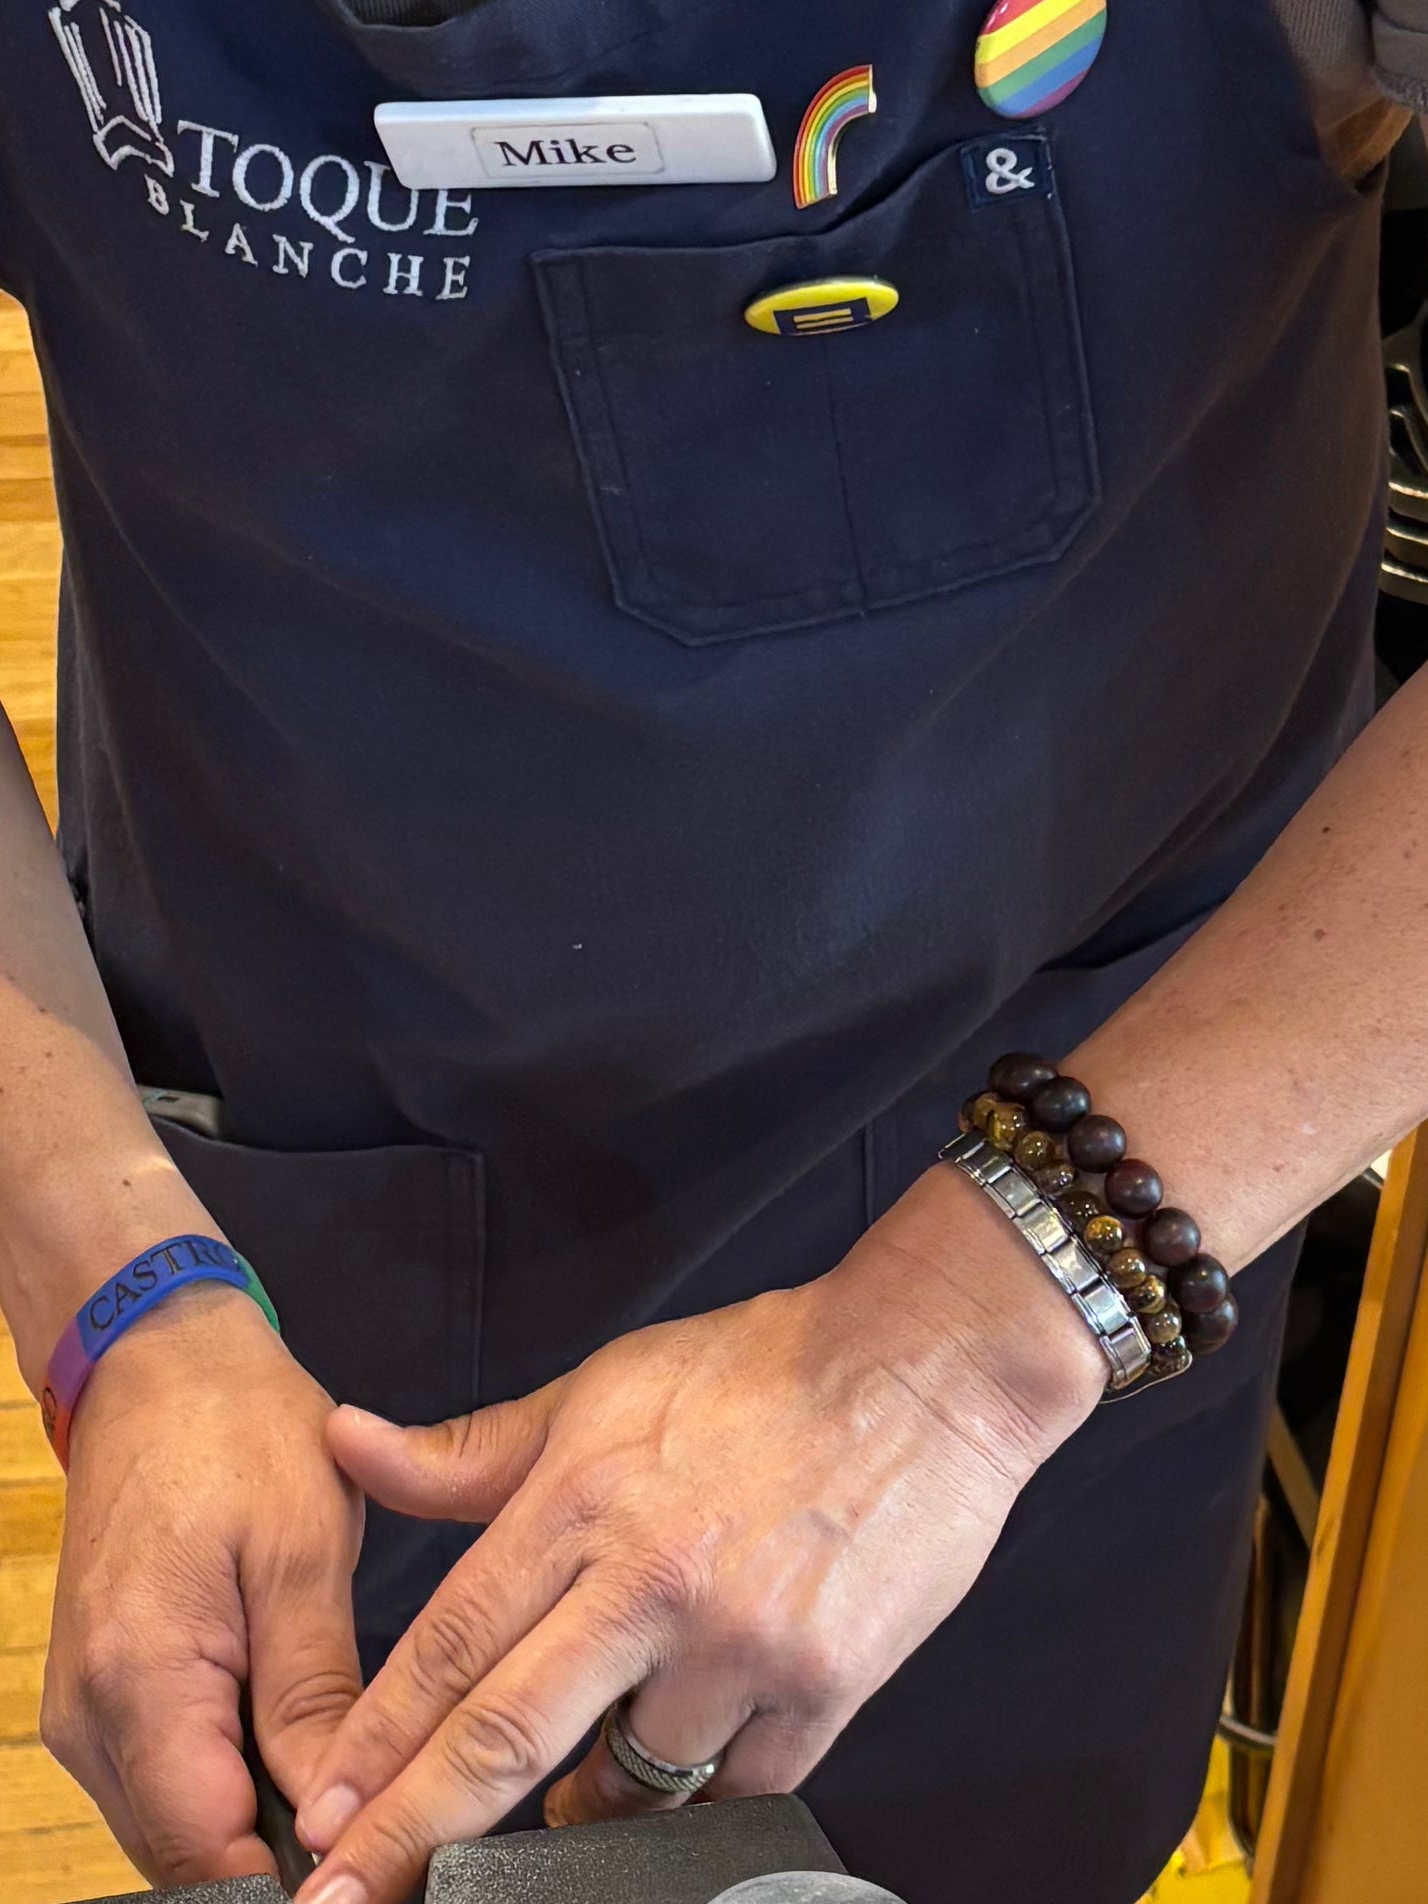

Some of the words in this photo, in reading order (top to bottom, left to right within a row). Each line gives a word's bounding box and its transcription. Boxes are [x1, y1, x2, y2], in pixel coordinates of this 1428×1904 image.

[175, 118, 478, 240] TOQUE
[493, 133, 637, 170] Mike
[984, 148, 1036, 195] &
[139, 175, 474, 304] BLANCHE
